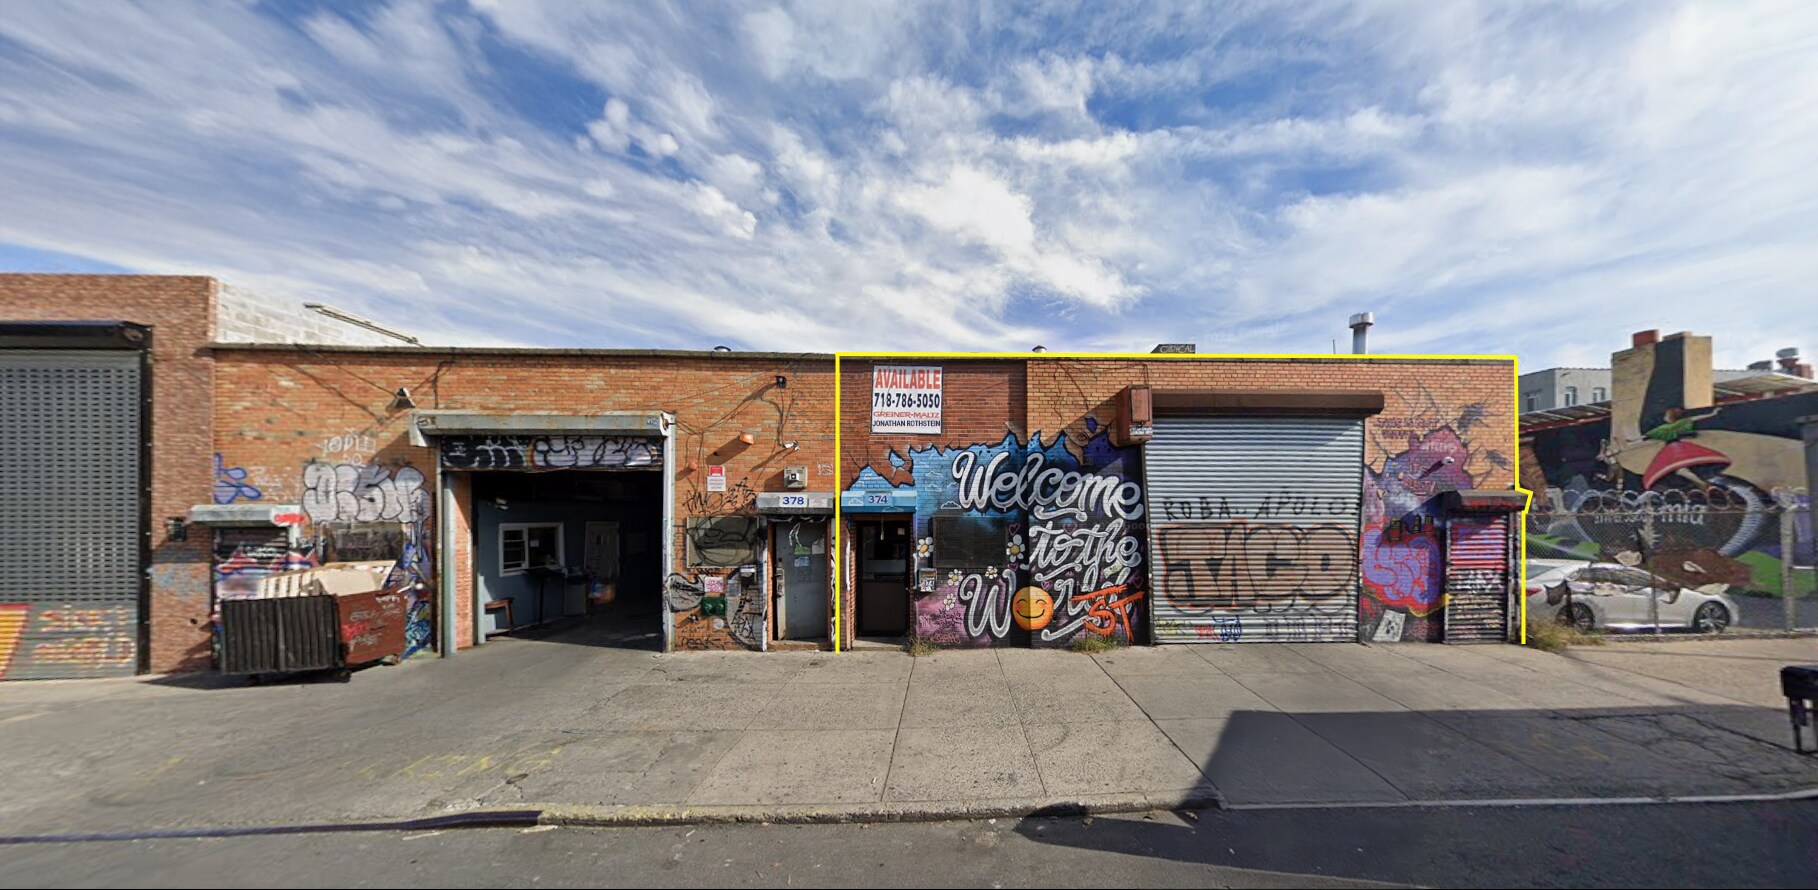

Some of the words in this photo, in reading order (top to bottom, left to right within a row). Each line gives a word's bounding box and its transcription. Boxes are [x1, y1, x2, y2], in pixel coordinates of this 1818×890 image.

[875, 369, 941, 389] AVAILABLE
[874, 392, 940, 408] 718-786-5050
[873, 411, 940, 419] GREINER-MALTZ
[952, 451, 1144, 520] Welcome
[782, 496, 804, 505] 378
[867, 495, 888, 504] 374
[1028, 521, 1083, 569] to
[1072, 518, 1142, 567] the
